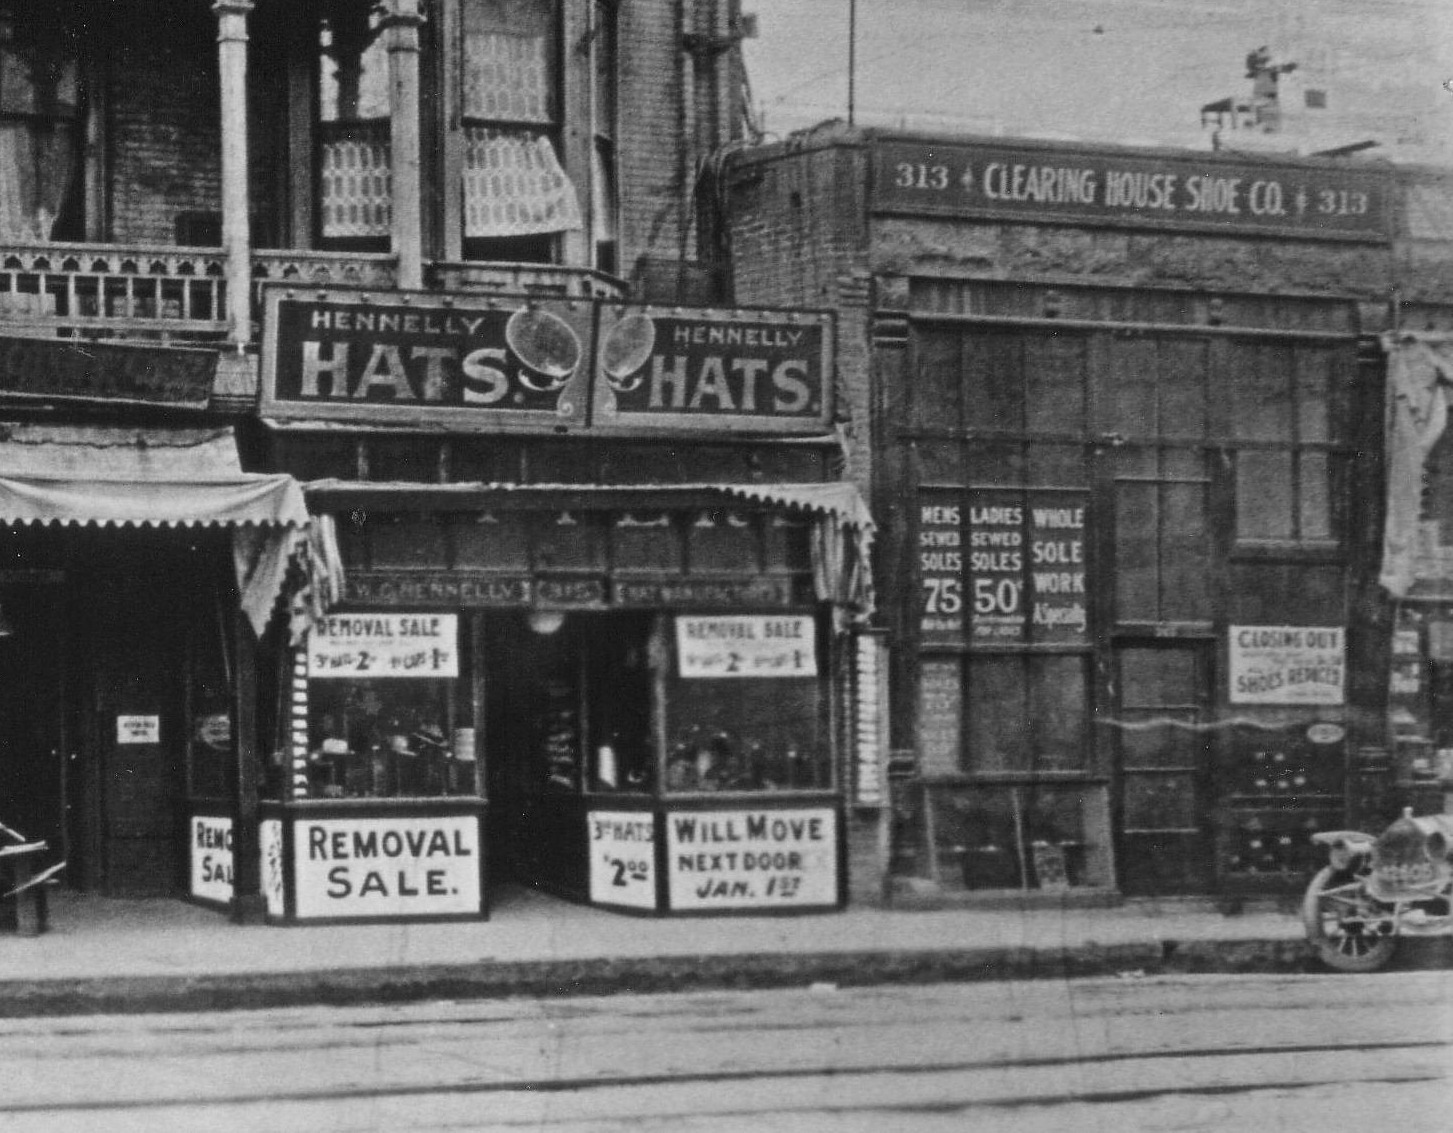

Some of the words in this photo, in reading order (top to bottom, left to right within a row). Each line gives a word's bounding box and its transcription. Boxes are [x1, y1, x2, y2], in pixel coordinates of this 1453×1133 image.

[896, 163, 948, 190] 313
[983, 162, 1096, 204] CLEARING
[1105, 170, 1177, 211] HOUSE
[1185, 175, 1242, 214] SHOE
[1249, 180, 1288, 216] CO.
[1318, 190, 1369, 215] 313
[311, 309, 486, 336] HENNELLY
[673, 325, 804, 348] HENNELLY
[920, 506, 961, 525] MENS
[969, 507, 1023, 525] LADIES
[1032, 508, 1085, 529] WHOLE
[919, 531, 961, 547] SEWED
[970, 532, 1022, 547] SEWED
[920, 552, 962, 571] SOLES
[970, 552, 1023, 571] SOLES
[1031, 541, 1083, 564] SOLE
[401, 581, 514, 599] HENNELLY
[1033, 572, 1086, 593] WORK
[316, 617, 394, 638] REMOVAL
[398, 617, 441, 638] SALE
[686, 621, 755, 639] REMOVAL
[764, 620, 803, 639] SALE
[1237, 630, 1303, 649] CLOSING
[1306, 631, 1338, 649] OUT
[674, 817, 742, 844] WILL
[747, 815, 823, 843] MOVE
[309, 825, 472, 861] REMOVAL
[678, 853, 739, 872] NEXT
[744, 851, 802, 871] DOOR
[326, 866, 459, 899] SALE.
[696, 877, 755, 898] JAN.
